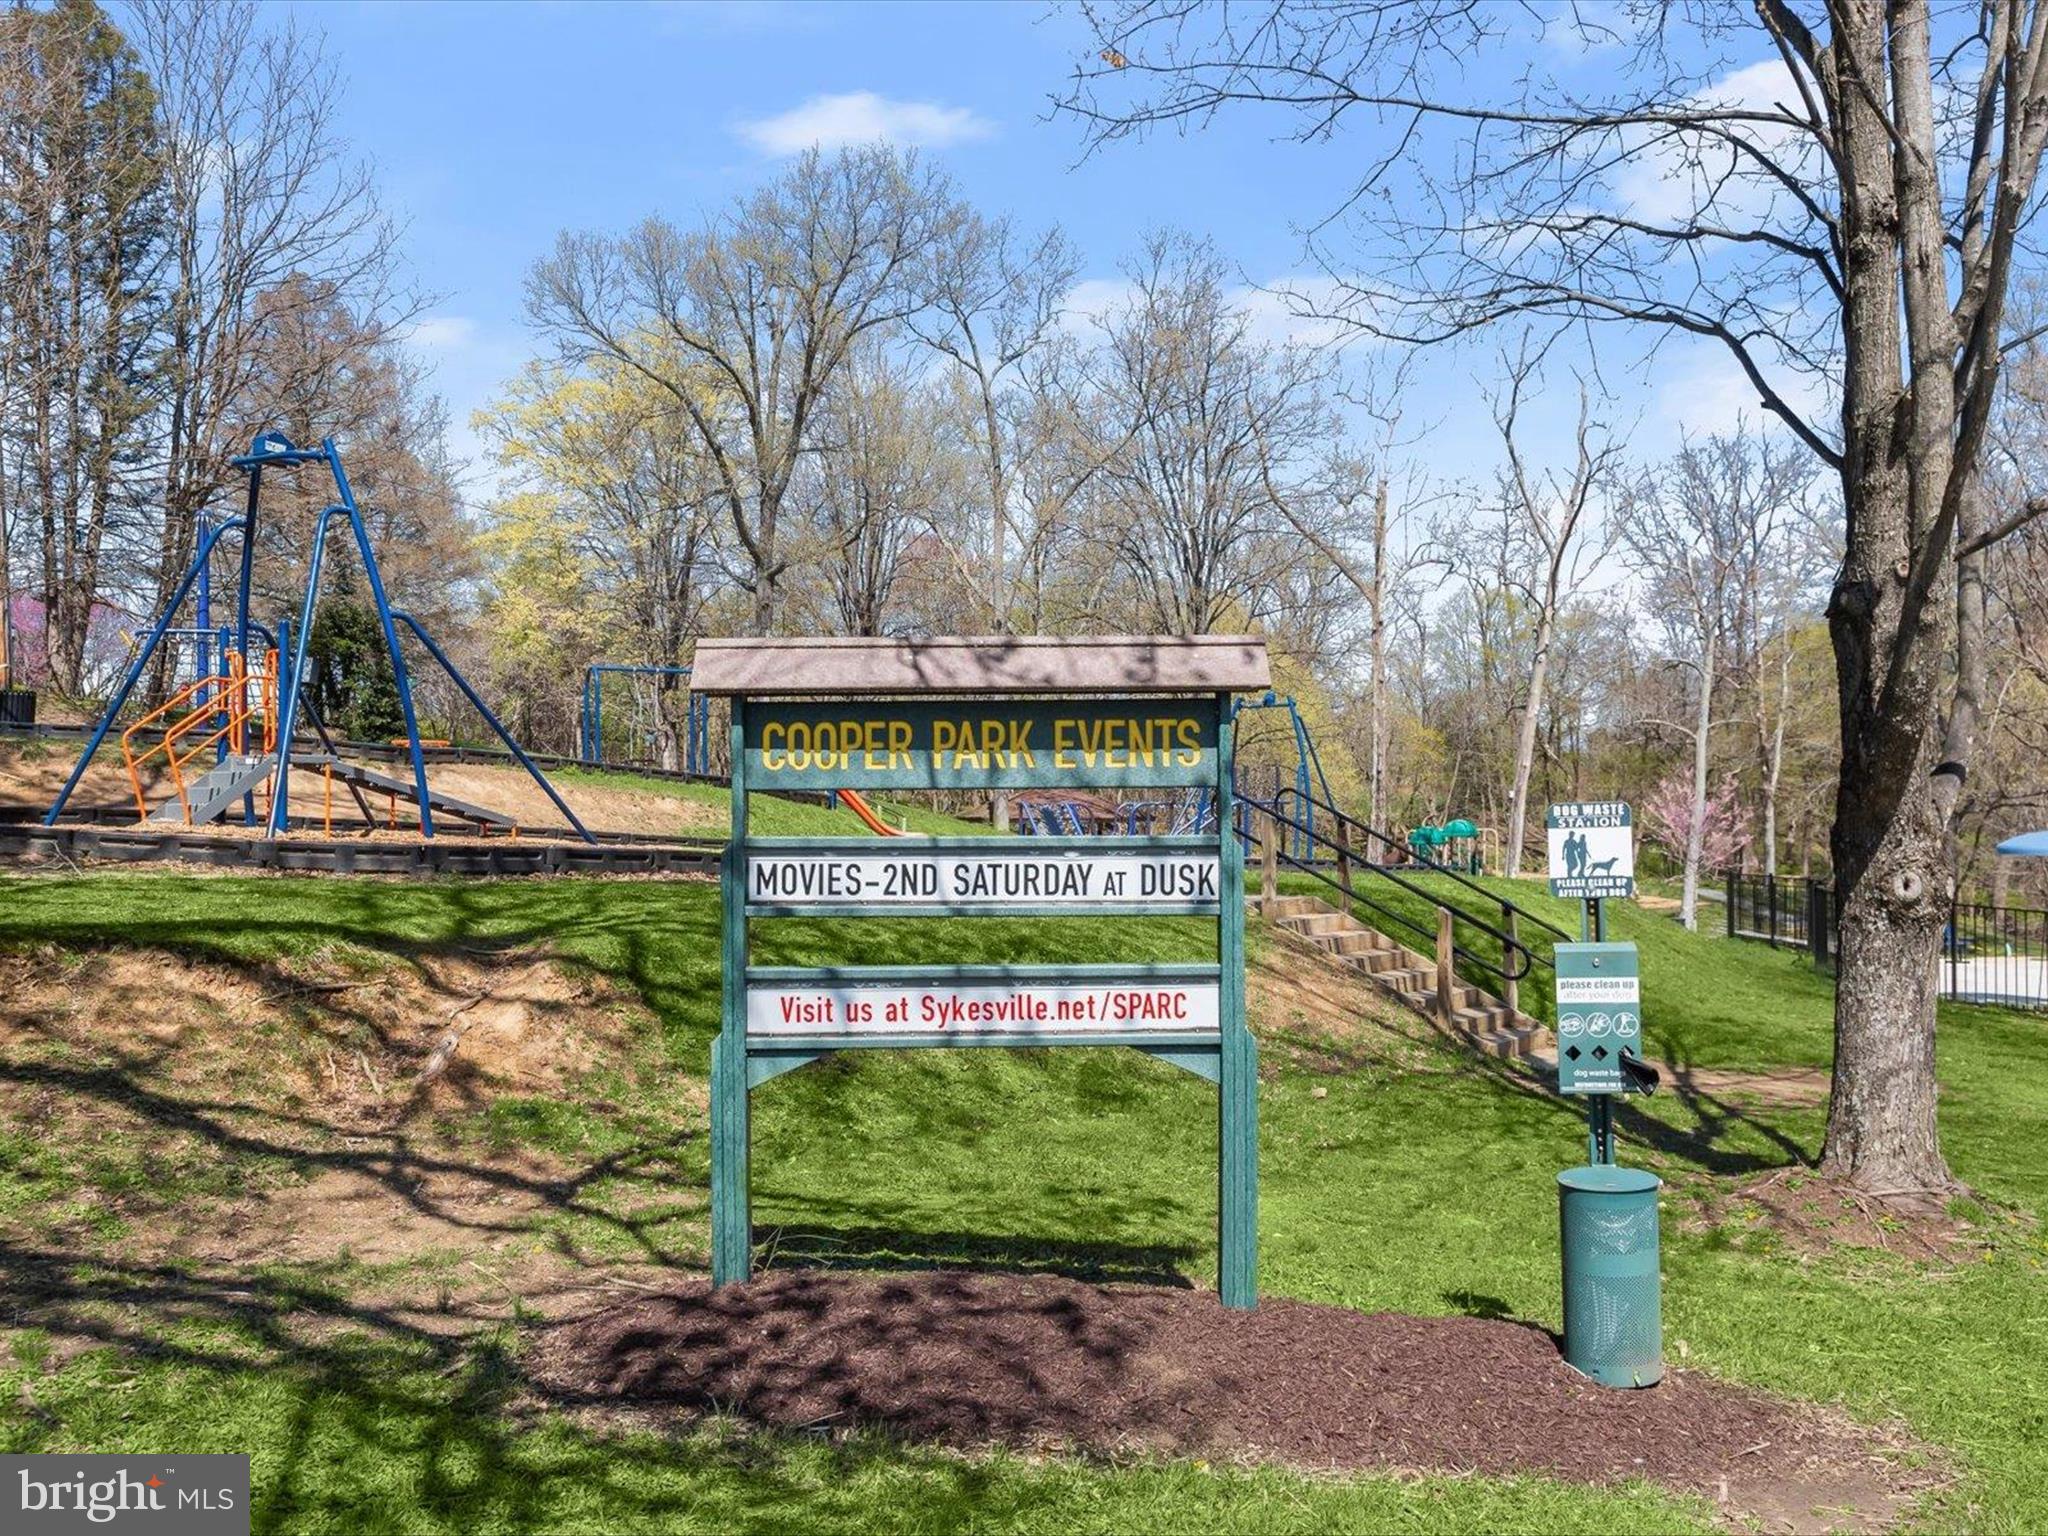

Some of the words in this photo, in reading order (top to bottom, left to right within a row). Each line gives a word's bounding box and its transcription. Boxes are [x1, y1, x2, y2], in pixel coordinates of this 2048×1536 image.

[761, 721, 913, 771] COOPER
[932, 720, 1036, 769] PARK
[1054, 718, 1202, 769] EVENTS
[1553, 805, 1578, 816] DOG
[1582, 804, 1624, 815] WASTE
[755, 863, 938, 896] MOVIES-2ND
[953, 863, 1093, 897] SATURDAY
[1103, 872, 1126, 896] AT
[1140, 863, 1216, 897] DUSK
[1557, 879, 1585, 888] PLEASE
[1588, 878, 1614, 887] CLEAN
[1616, 878, 1627, 887] UP
[1559, 889, 1583, 897] AFTER
[1609, 888, 1627, 896] DOG
[1560, 980, 1592, 990] please
[1594, 980, 1620, 989] clean
[1623, 981, 1635, 990] up
[1564, 990, 1586, 999] after
[1612, 990, 1632, 1000] dog
[780, 998, 833, 1023] Visit
[846, 1004, 873, 1022] us
[885, 999, 909, 1022] at
[921, 991, 1188, 1029] Sykesville.net/SPARC
[1574, 1069, 1588, 1078] dog
